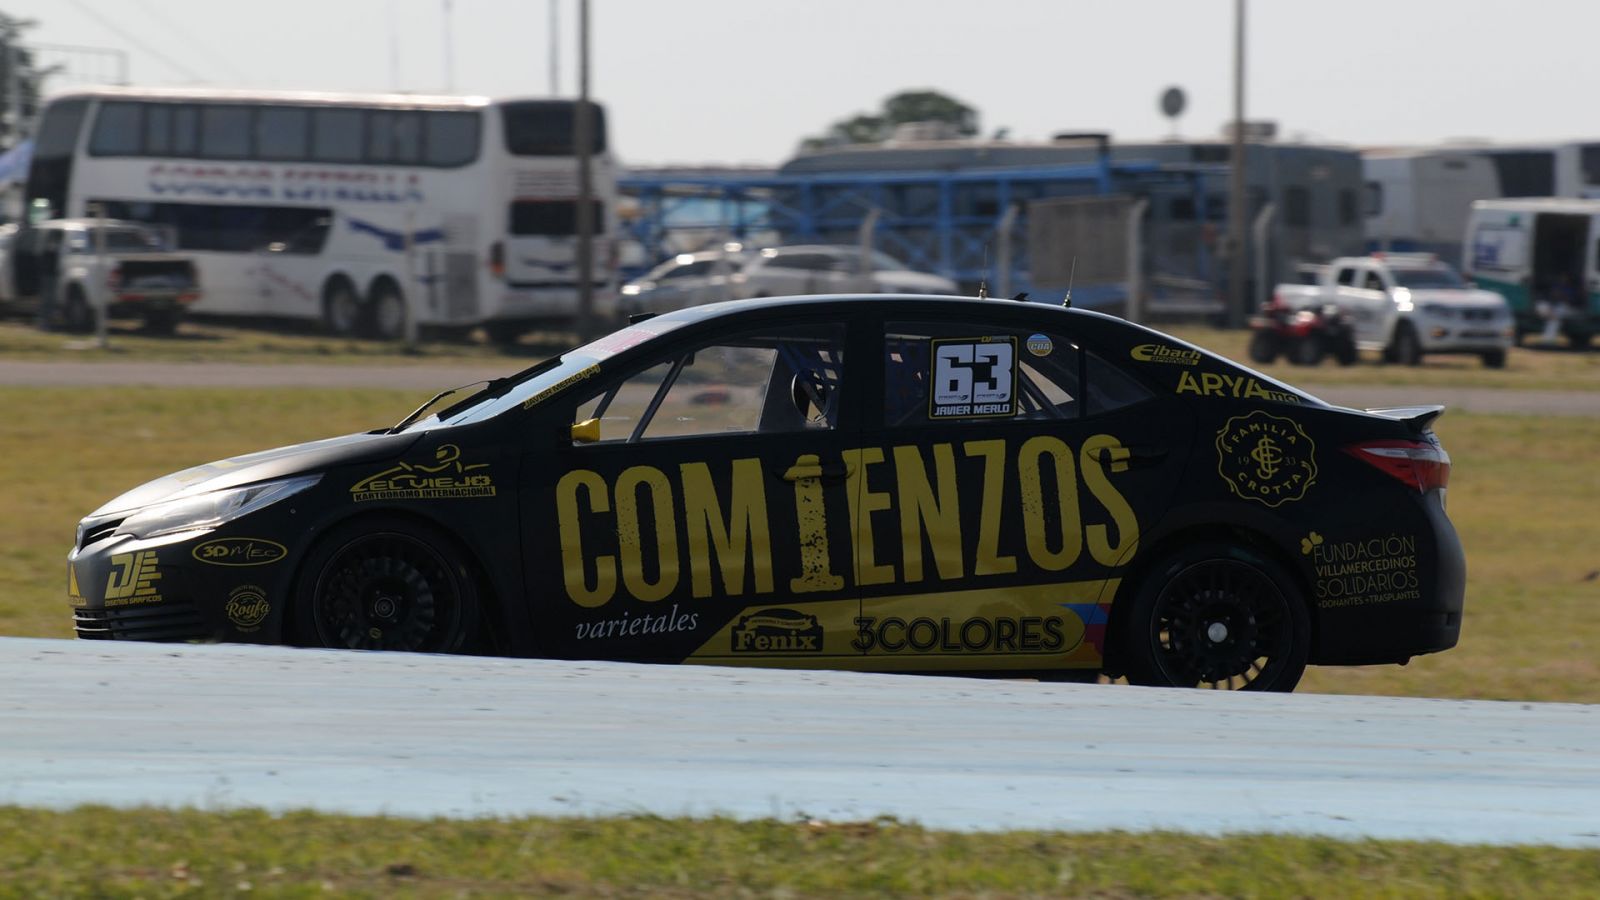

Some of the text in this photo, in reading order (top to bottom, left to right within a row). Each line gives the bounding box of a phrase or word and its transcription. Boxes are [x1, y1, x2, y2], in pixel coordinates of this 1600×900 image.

[1130, 343, 1201, 362] Eibach
[935, 343, 1013, 405] 63
[1175, 370, 1269, 400] ARYA
[934, 403, 1010, 416] JAVIER MERLO
[1231, 423, 1297, 445] FAMILIA
[1237, 456, 1297, 466] 19 33
[355, 487, 495, 501] KARTODROMO INTERNACIONAL
[1238, 472, 1302, 495] CROTTA
[1313, 532, 1415, 563] FUNDACIÓN
[1315, 555, 1417, 576] VILLAMERCEDINOS
[1316, 570, 1419, 598] SOLIDARIOS
[225, 600, 271, 619] Royfa
[575, 603, 699, 640] varietales
[736, 630, 817, 650] Fenix
[851, 616, 1064, 652] 3COLORES
